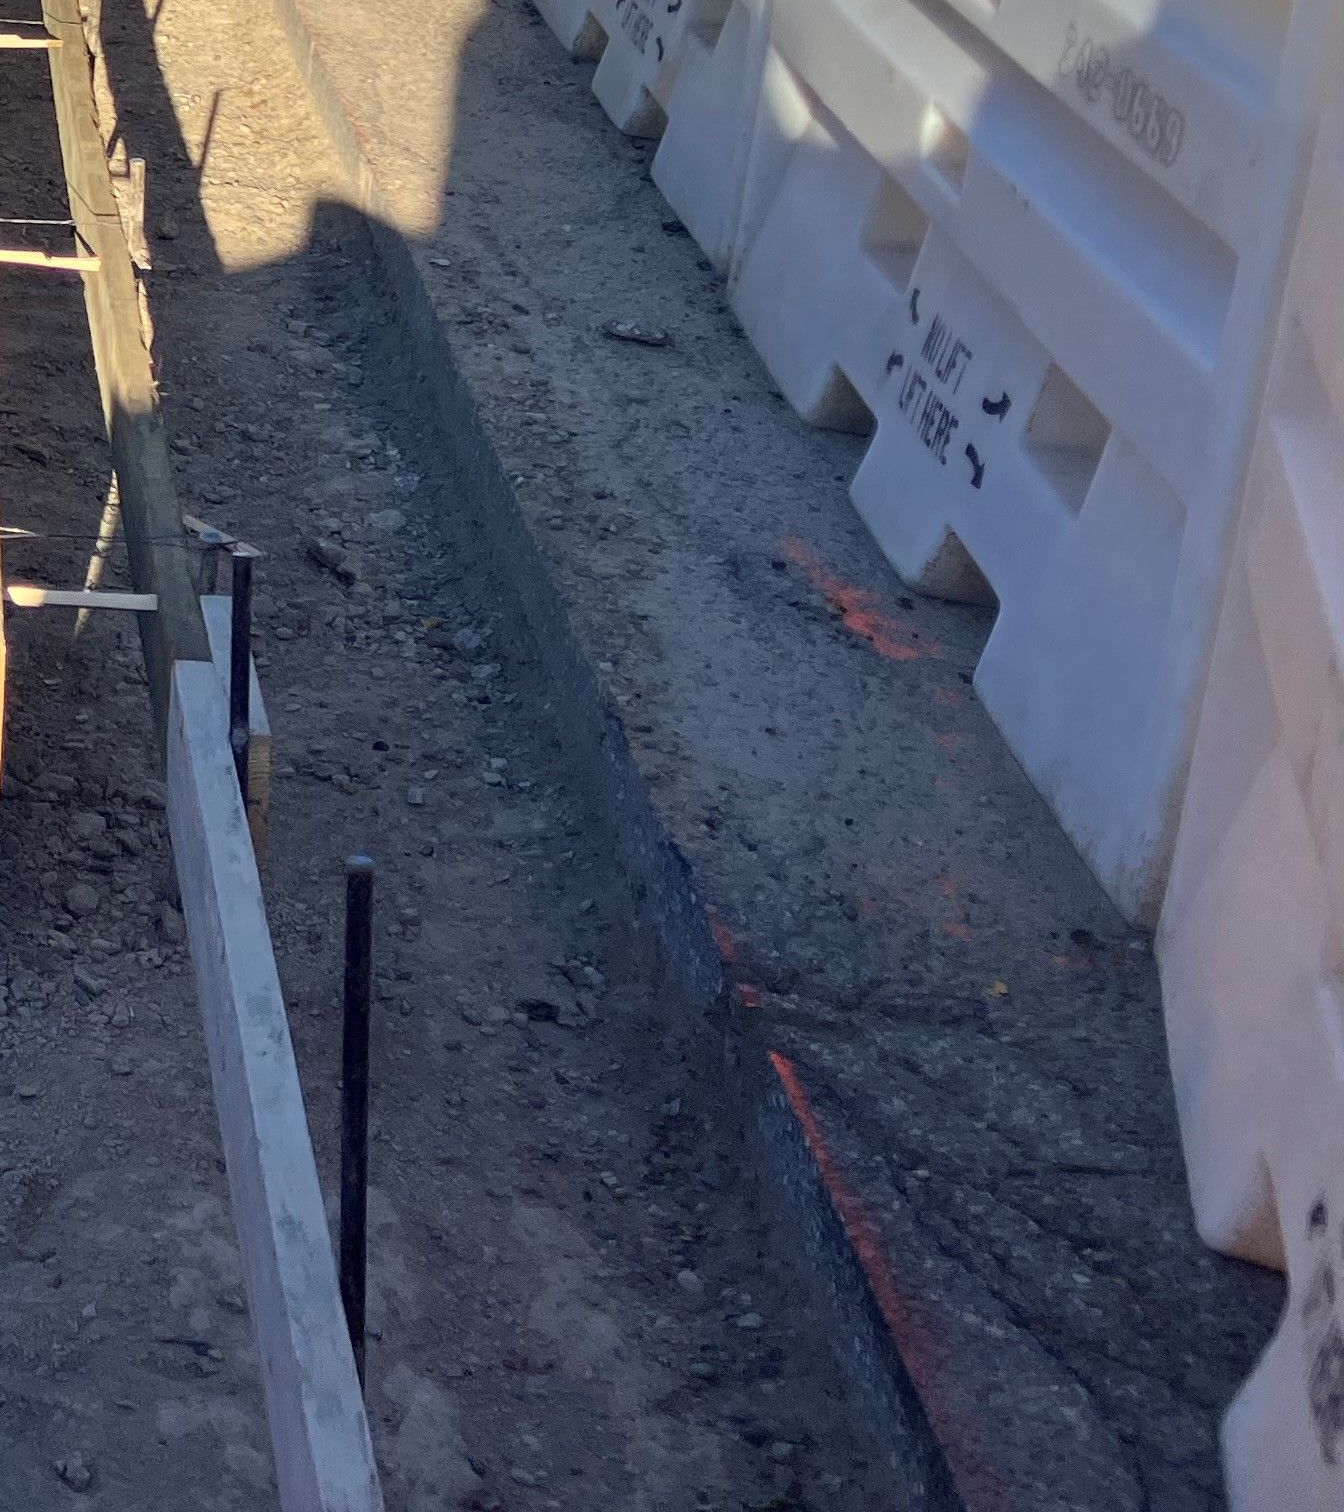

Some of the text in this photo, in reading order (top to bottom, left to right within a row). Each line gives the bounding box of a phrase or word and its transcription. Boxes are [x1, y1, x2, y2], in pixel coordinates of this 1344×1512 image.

[935, 330, 974, 395] LIFT
[898, 362, 960, 466] LIFT HERE
